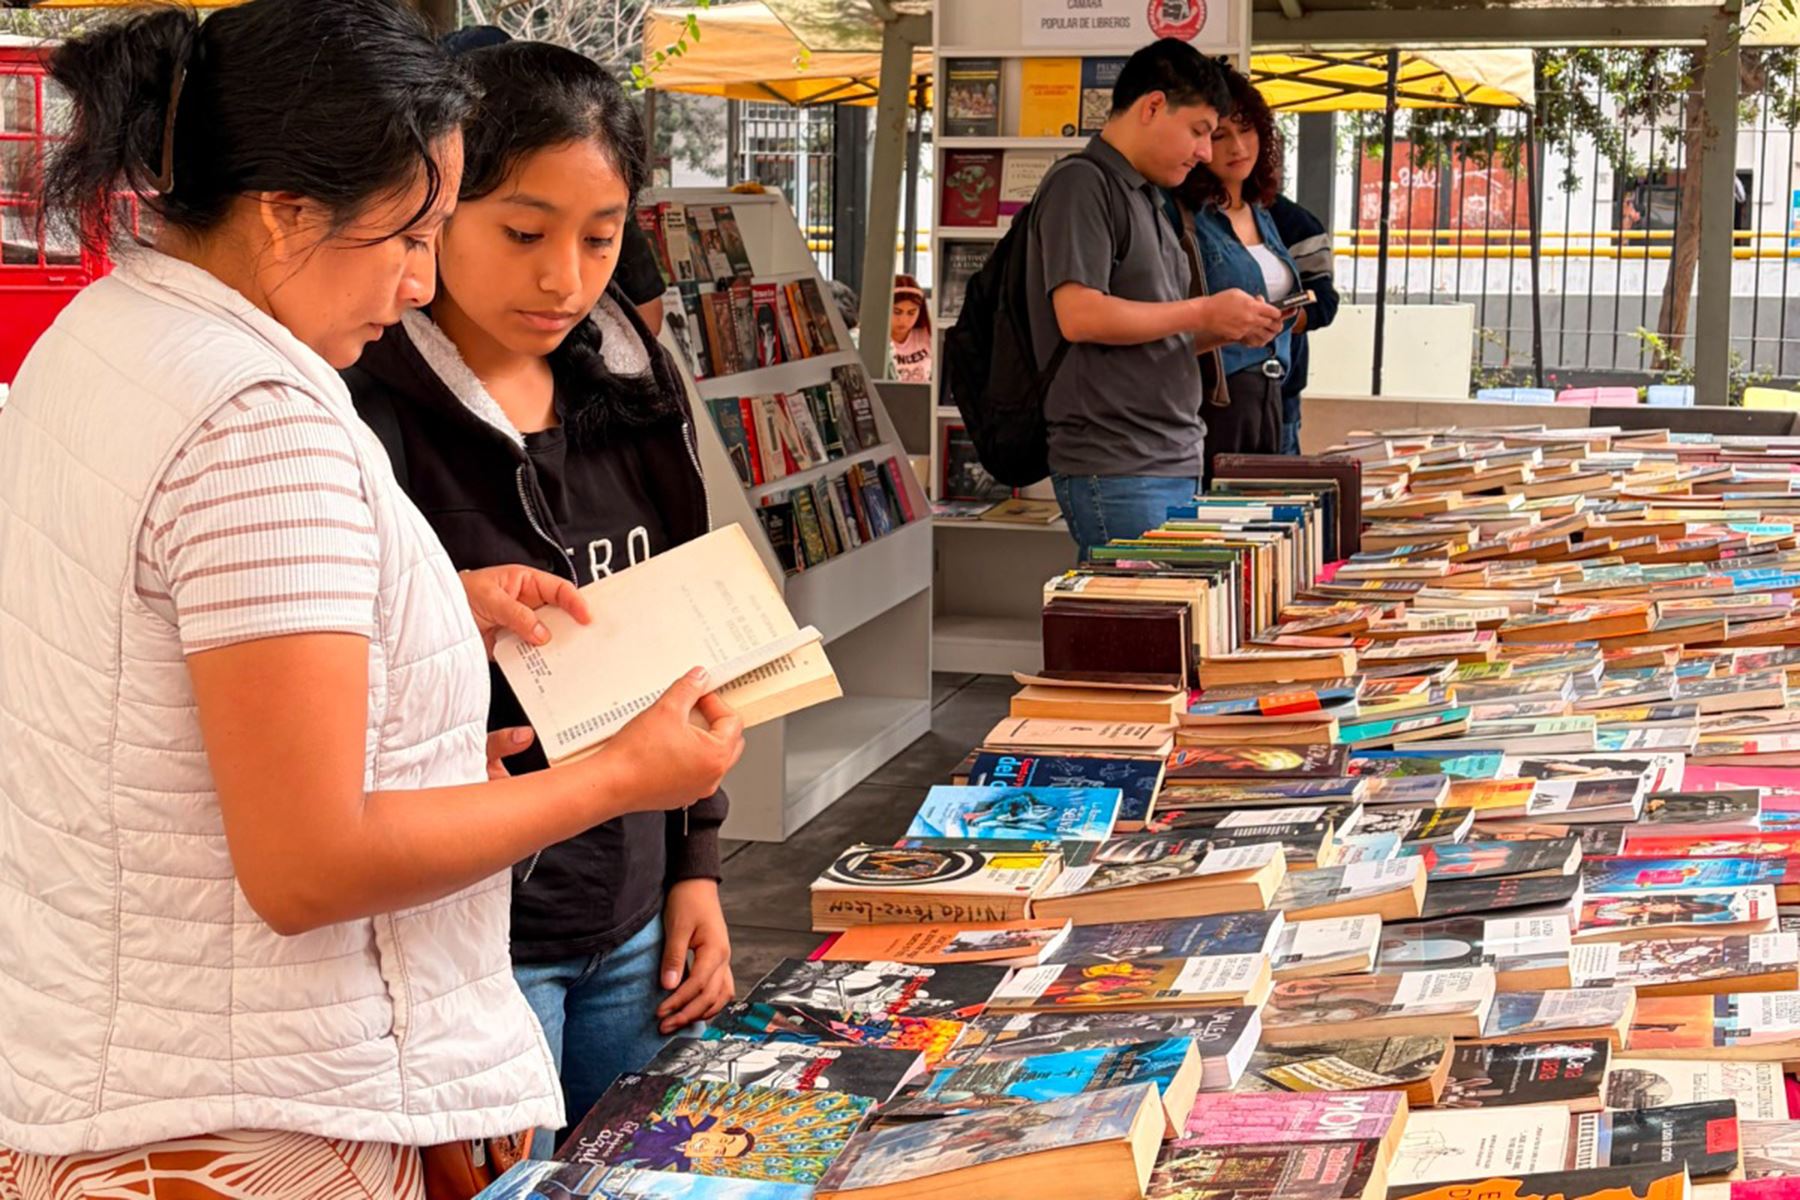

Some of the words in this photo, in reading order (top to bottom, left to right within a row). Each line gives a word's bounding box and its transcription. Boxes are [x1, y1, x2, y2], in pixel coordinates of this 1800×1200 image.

[1041, 18, 1078, 29] POPULAR
[1080, 18, 1090, 28] DE
[1092, 17, 1131, 28] LIBREROS
[1057, 807, 1080, 833] selva
